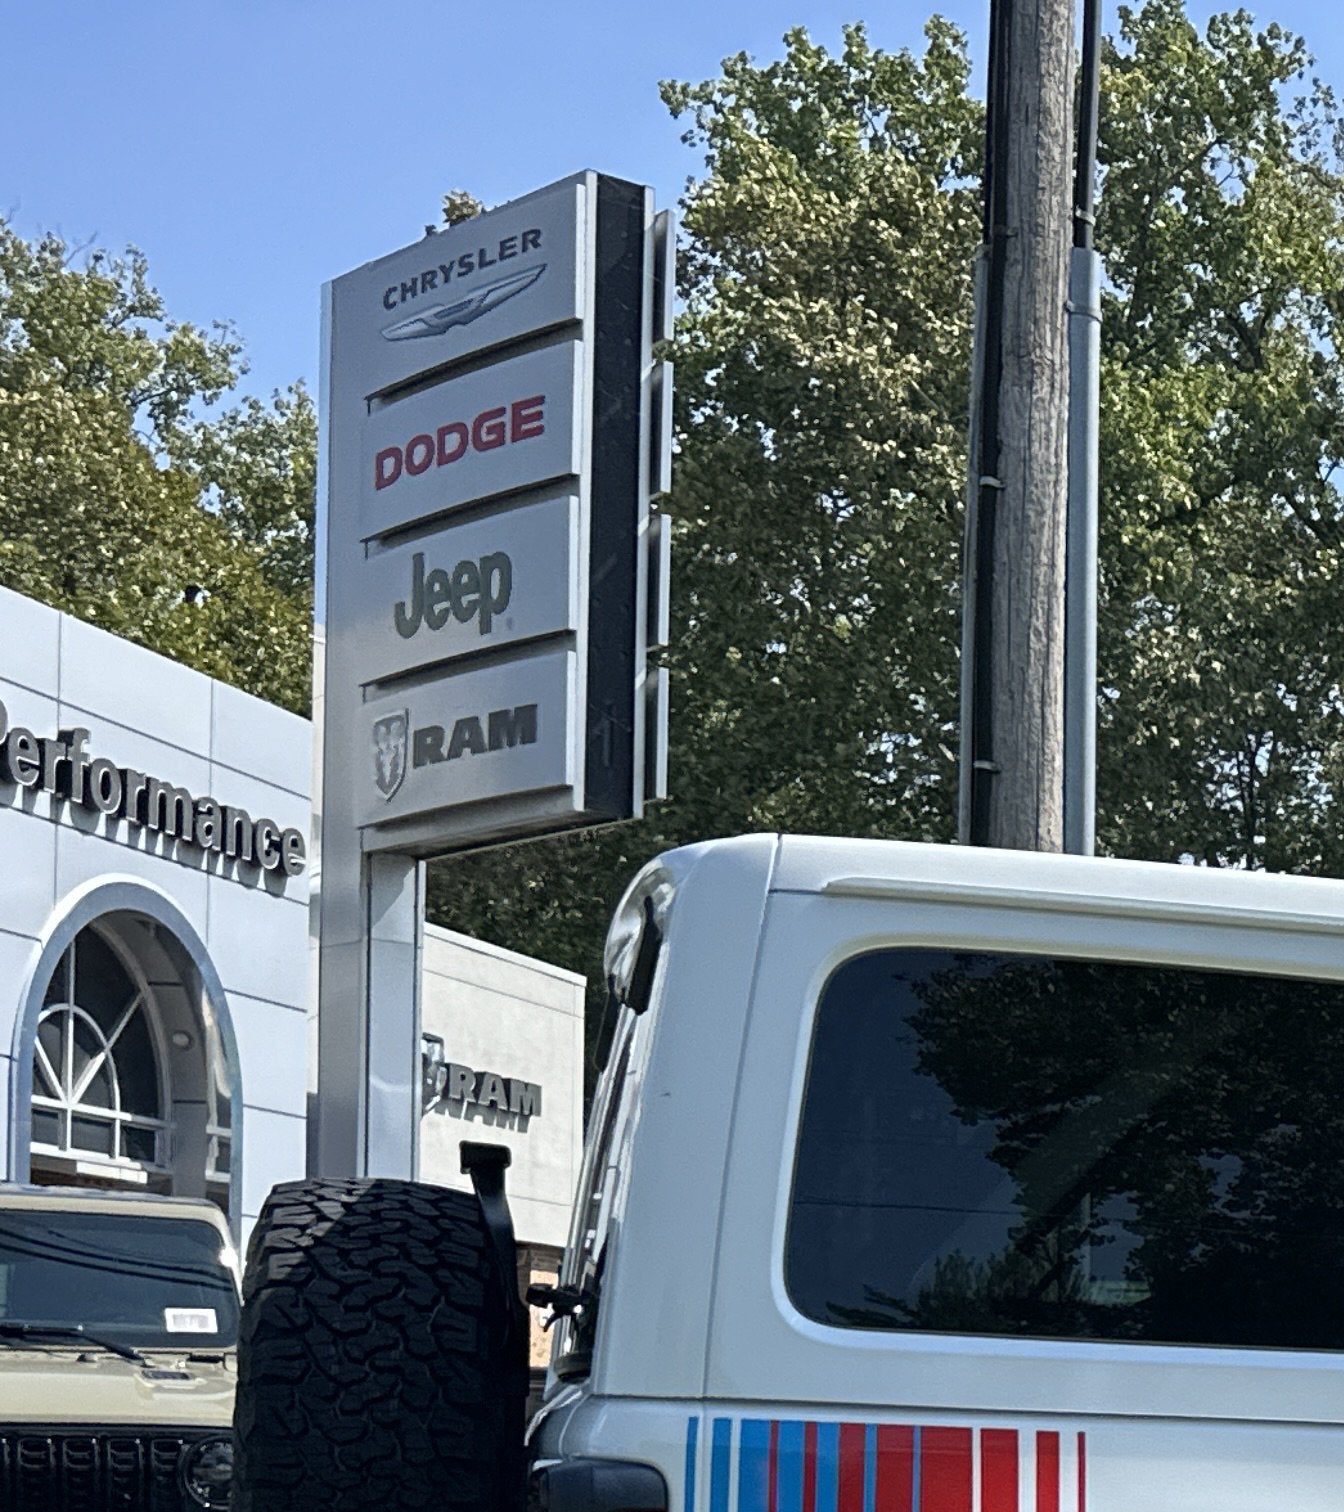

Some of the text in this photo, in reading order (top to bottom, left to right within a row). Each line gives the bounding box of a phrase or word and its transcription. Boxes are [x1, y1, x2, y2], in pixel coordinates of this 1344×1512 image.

[383, 228, 542, 310] CHRYSLER
[375, 394, 546, 491] DODGE
[394, 551, 512, 640] Jeep
[413, 703, 538, 769] RAM
[0, 700, 306, 877] erformance
[448, 1062, 542, 1118] RAM
